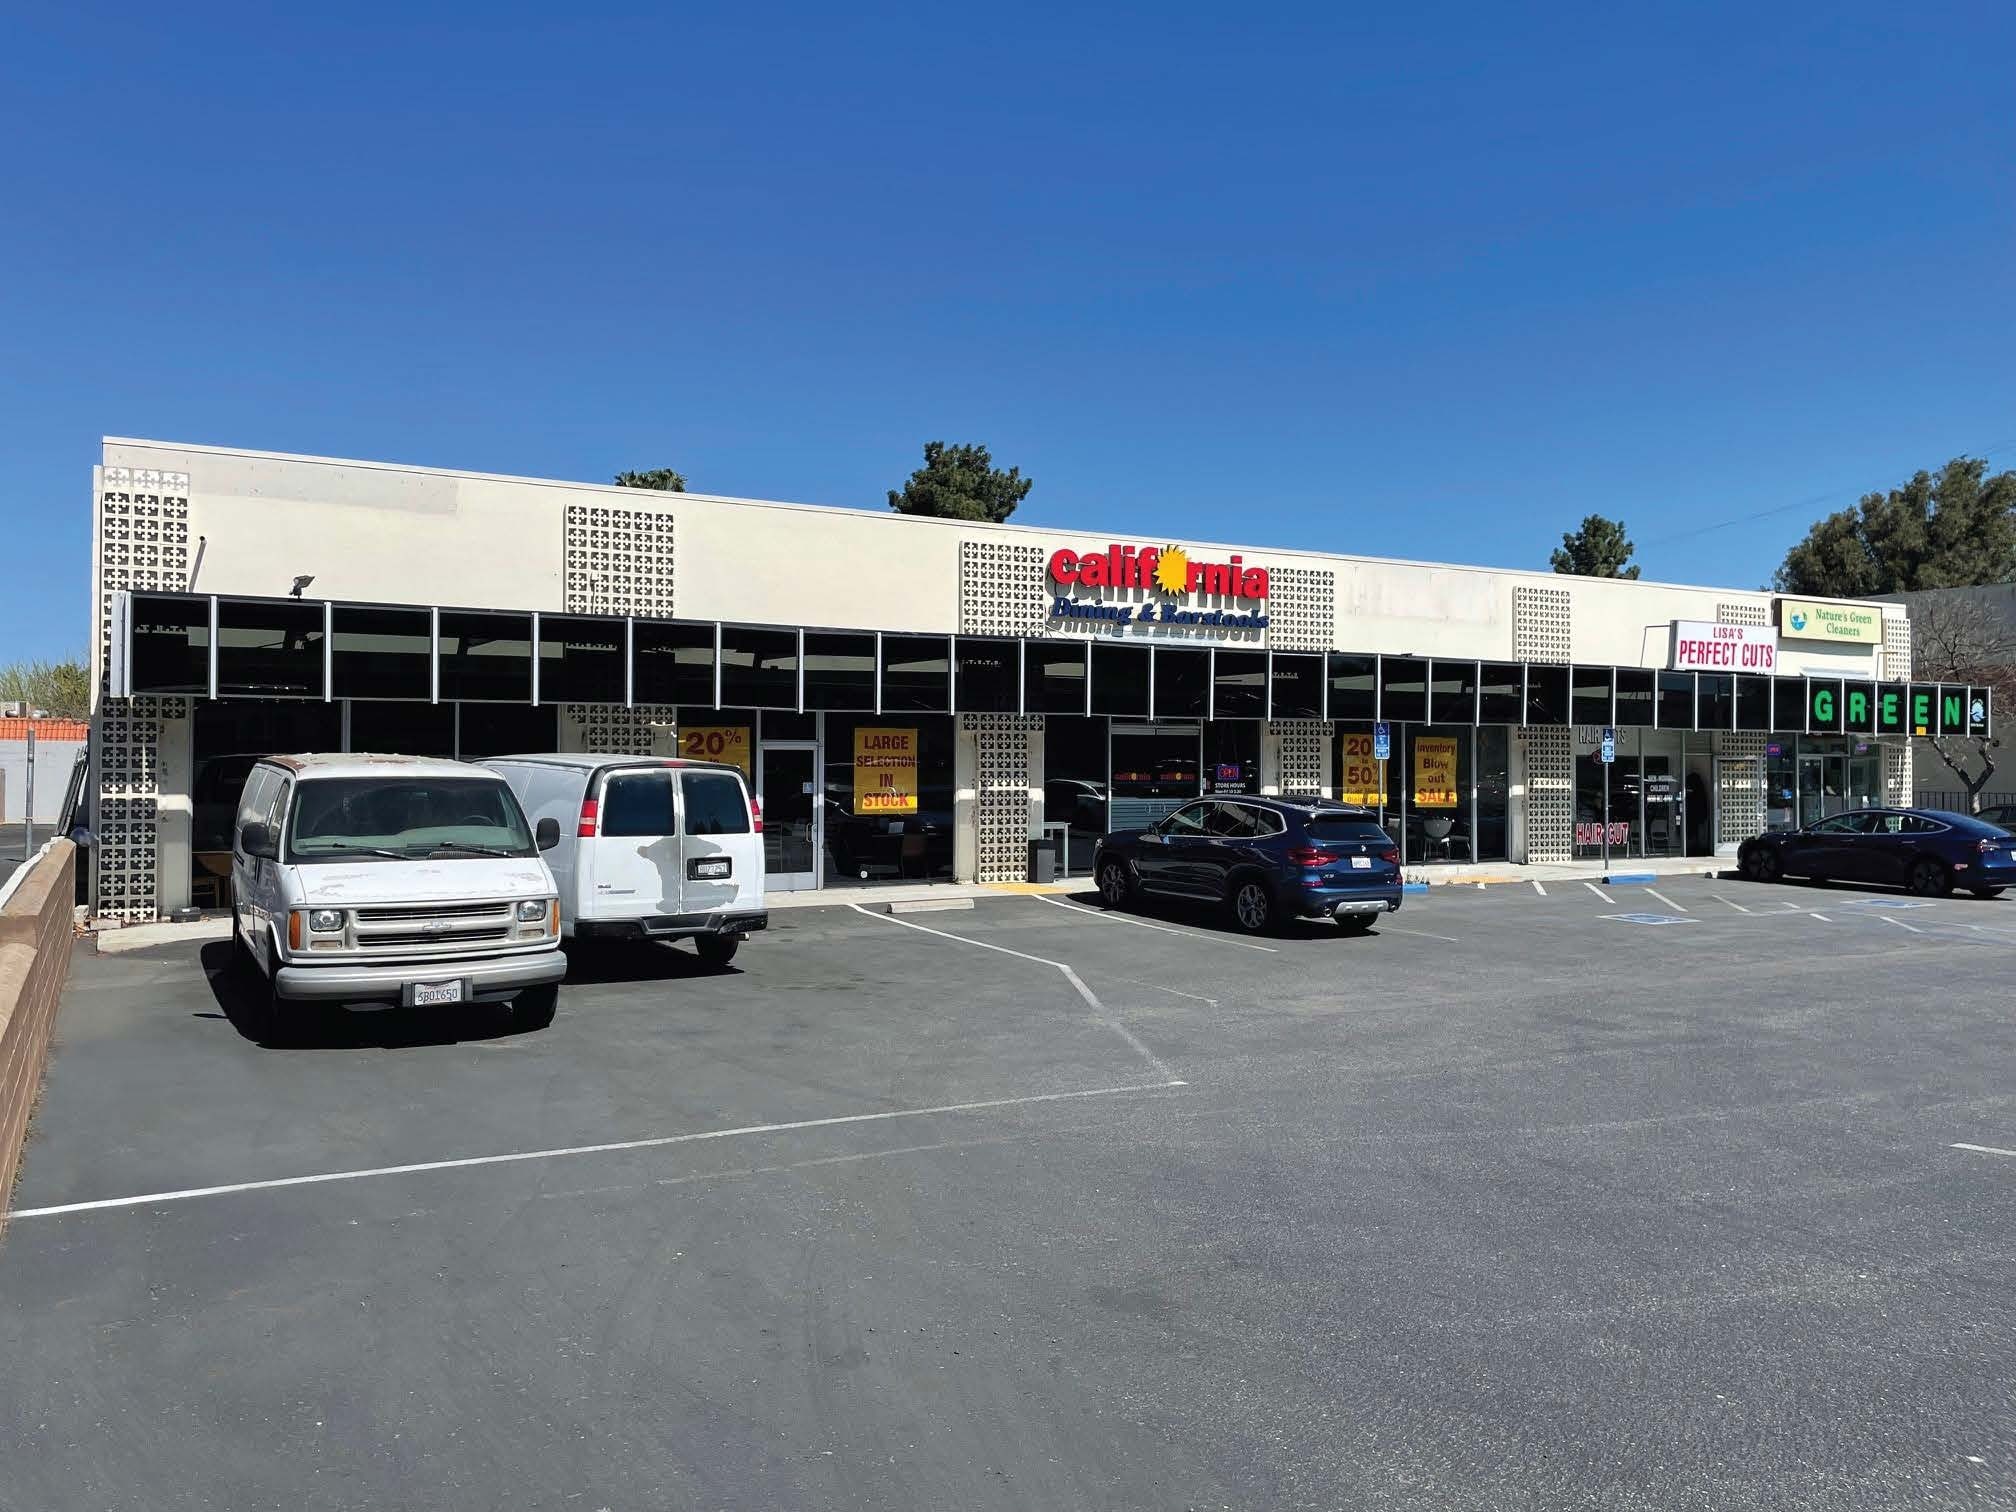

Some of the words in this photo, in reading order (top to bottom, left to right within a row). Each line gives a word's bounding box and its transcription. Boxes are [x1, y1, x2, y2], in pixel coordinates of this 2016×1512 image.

[1051, 597, 1133, 625] Dining
[1138, 602, 1157, 622] &
[1158, 602, 1269, 629] Barstools
[1815, 608, 1848, 623] Nature's
[1849, 613, 1873, 625] Green
[1713, 626, 1744, 640] LISA'S
[1826, 622, 1861, 637] Cleaners
[1679, 640, 1738, 667] PERFECT
[1741, 644, 1774, 669] CUTS
[1814, 690, 1961, 726] GREEN
[685, 730, 742, 755] 20%
[864, 735, 909, 750] LARGE
[1578, 726, 1600, 744] HAIR
[1417, 743, 1456, 755] Inventory
[855, 755, 917, 768] SELECTION
[1423, 758, 1449, 769] Blow
[879, 773, 894, 787] IN
[1219, 767, 1238, 778] OPEN
[1428, 773, 1446, 784] out
[863, 792, 909, 807] STOCK
[1418, 789, 1455, 803] SALE
[1576, 822, 1603, 845] HAIR
[1607, 822, 1629, 845] CUT
